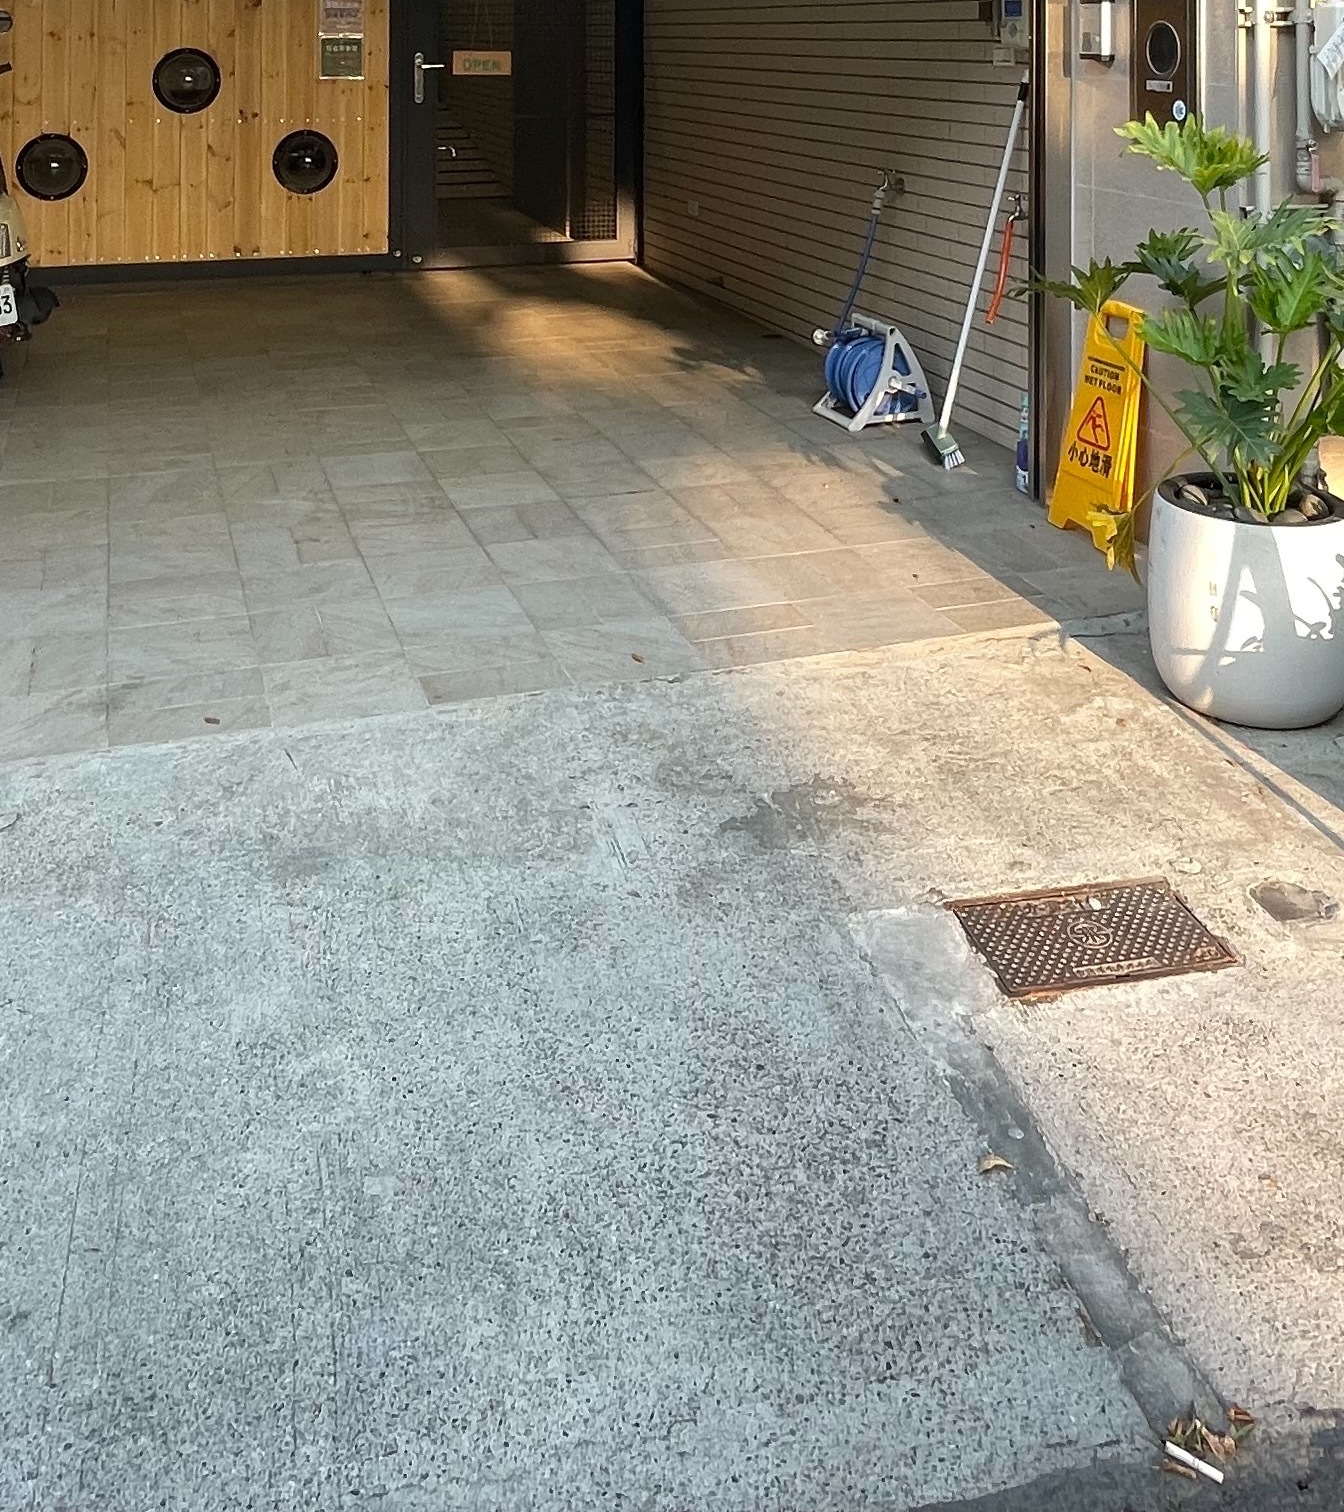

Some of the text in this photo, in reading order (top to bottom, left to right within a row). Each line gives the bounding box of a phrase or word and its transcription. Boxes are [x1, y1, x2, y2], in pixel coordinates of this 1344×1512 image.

[1090, 364, 1120, 381] CAUTION
[1068, 440, 1113, 479] 小心地滑
